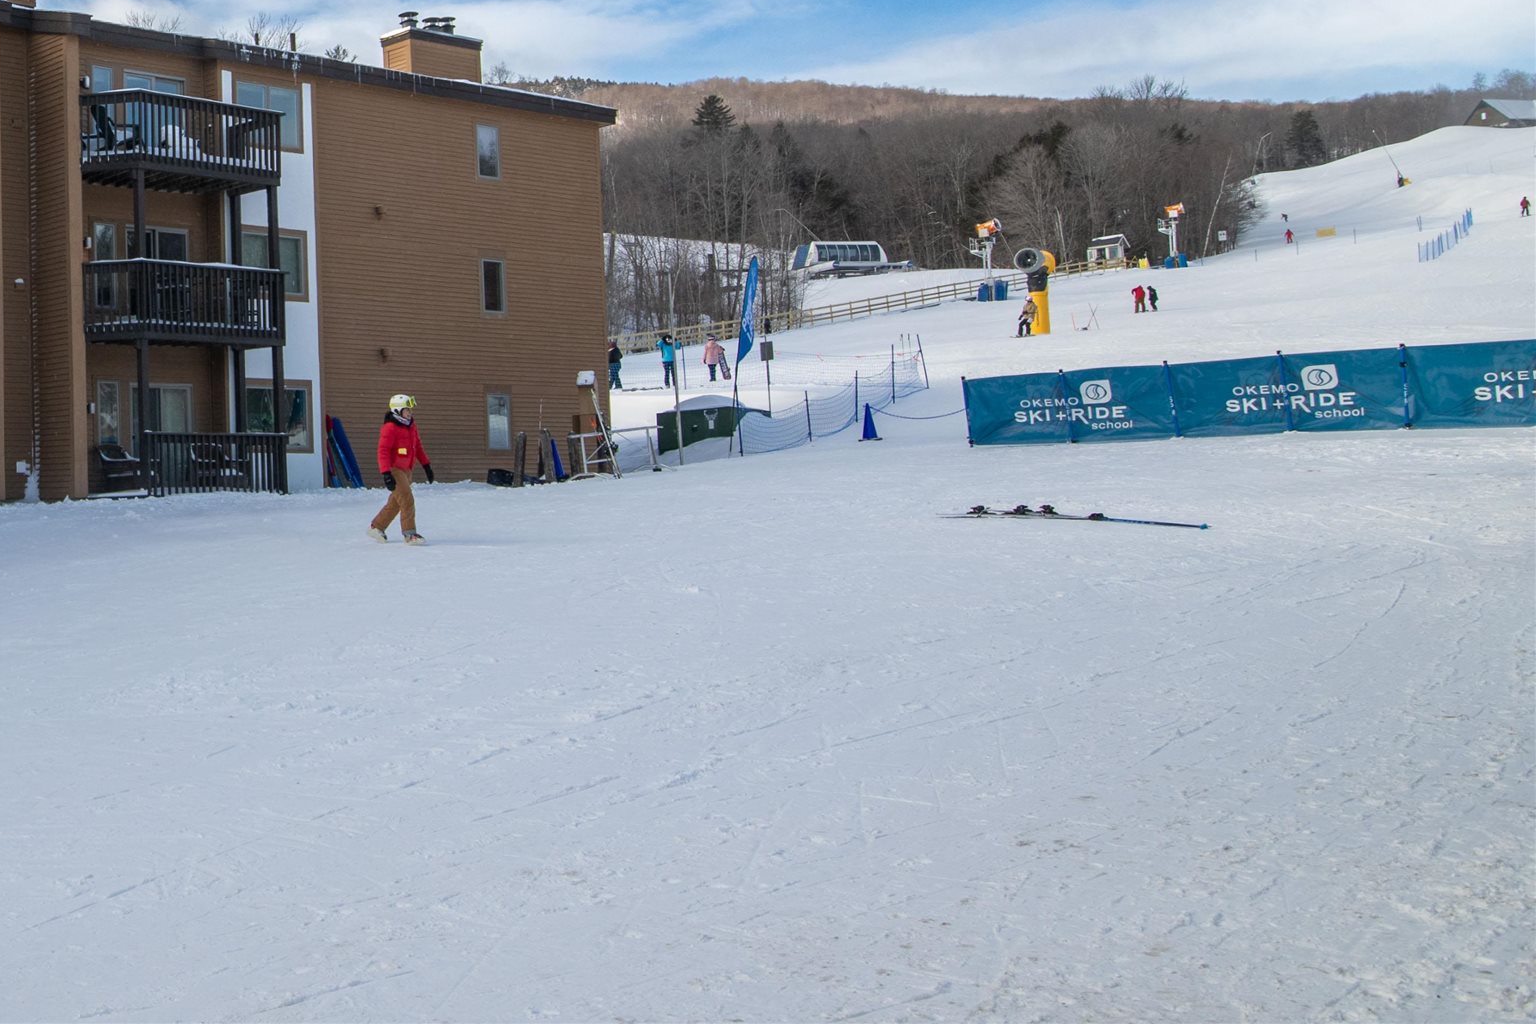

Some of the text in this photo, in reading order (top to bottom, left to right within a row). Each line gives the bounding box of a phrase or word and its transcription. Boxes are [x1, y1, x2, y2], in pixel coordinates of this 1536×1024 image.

[1232, 383, 1299, 396] OKEMO
[1020, 397, 1079, 408] OKEMO
[1315, 407, 1364, 418] school
[1091, 420, 1133, 430] school
